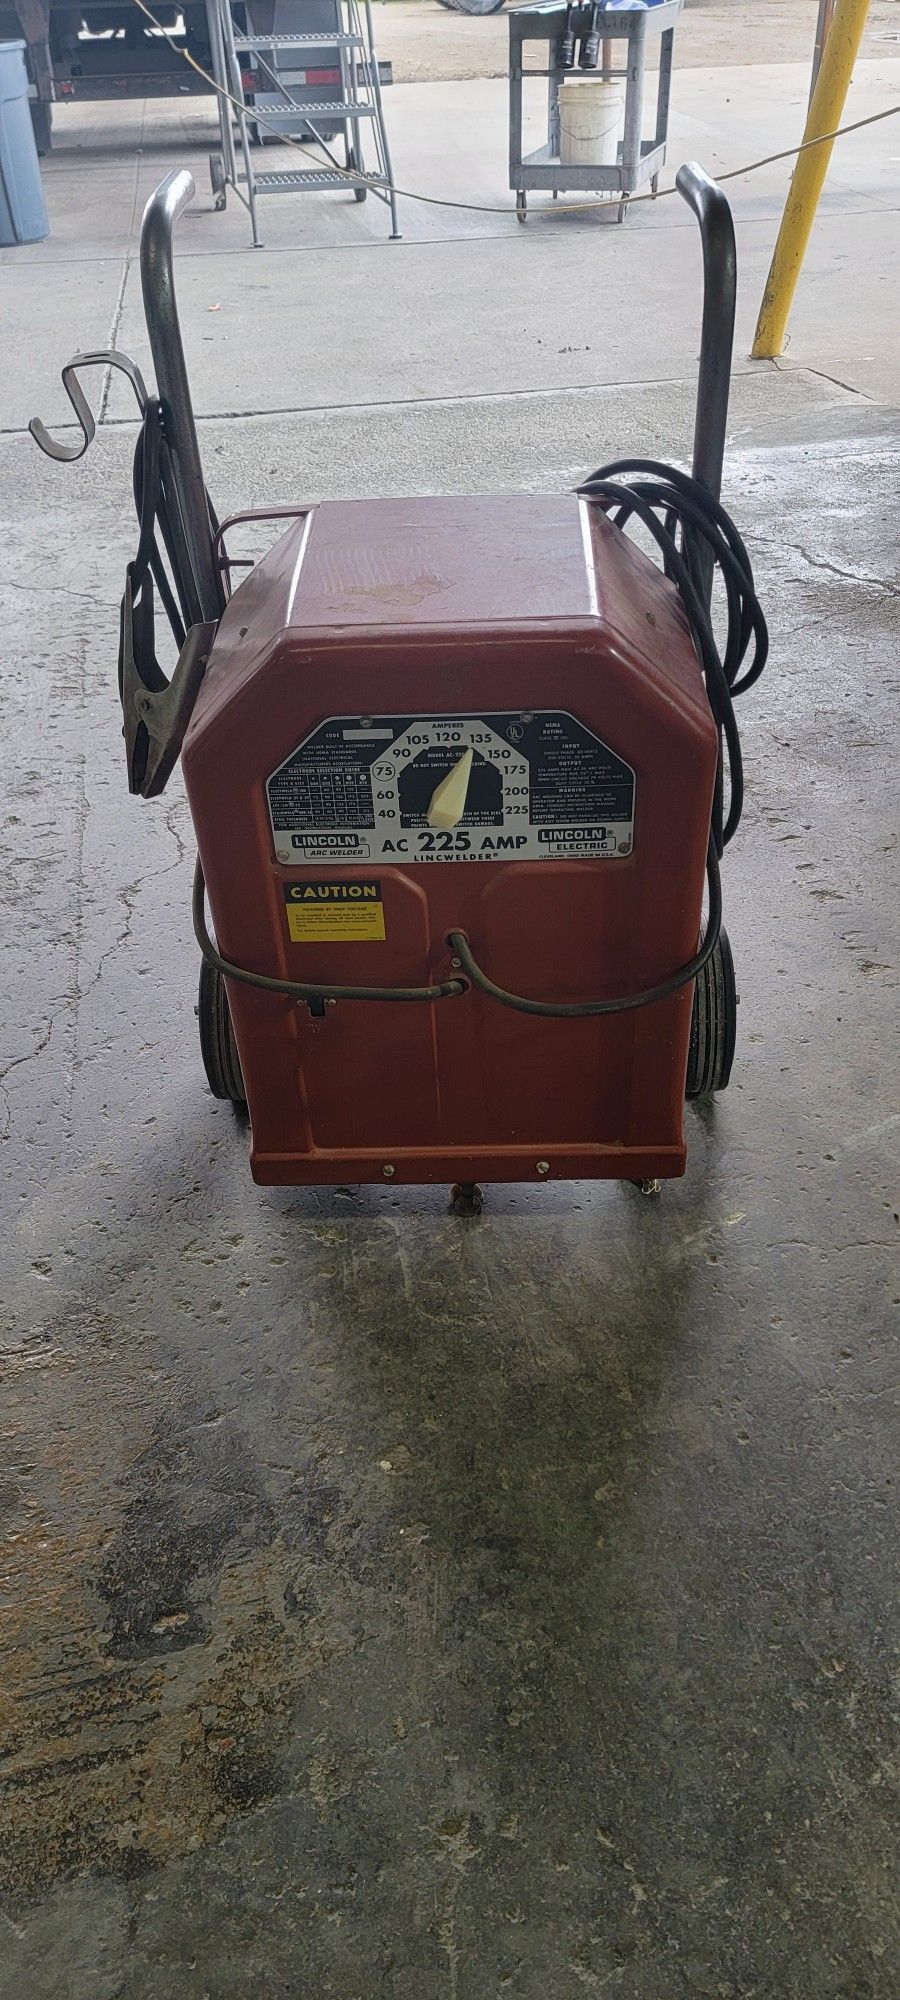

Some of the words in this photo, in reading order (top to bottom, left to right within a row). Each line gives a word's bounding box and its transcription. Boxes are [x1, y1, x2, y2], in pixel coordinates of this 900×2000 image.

[510, 726, 520, 737] UL
[406, 734, 430, 745] 105
[436, 732, 461, 742] 120
[469, 734, 492, 743] 135
[392, 748, 411, 758] 90
[487, 749, 511, 759] 150
[376, 766, 393, 776] 75
[503, 765, 527, 775] 175
[376, 790, 394, 800] 60
[504, 786, 529, 796] 200
[378, 809, 396, 818] 40
[504, 806, 529, 814] 225
[381, 839, 408, 852] AC
[417, 831, 472, 852] 225
[480, 835, 528, 850] AMP
[556, 842, 608, 851] ELECTRIC
[290, 885, 376, 898] CAUTION
